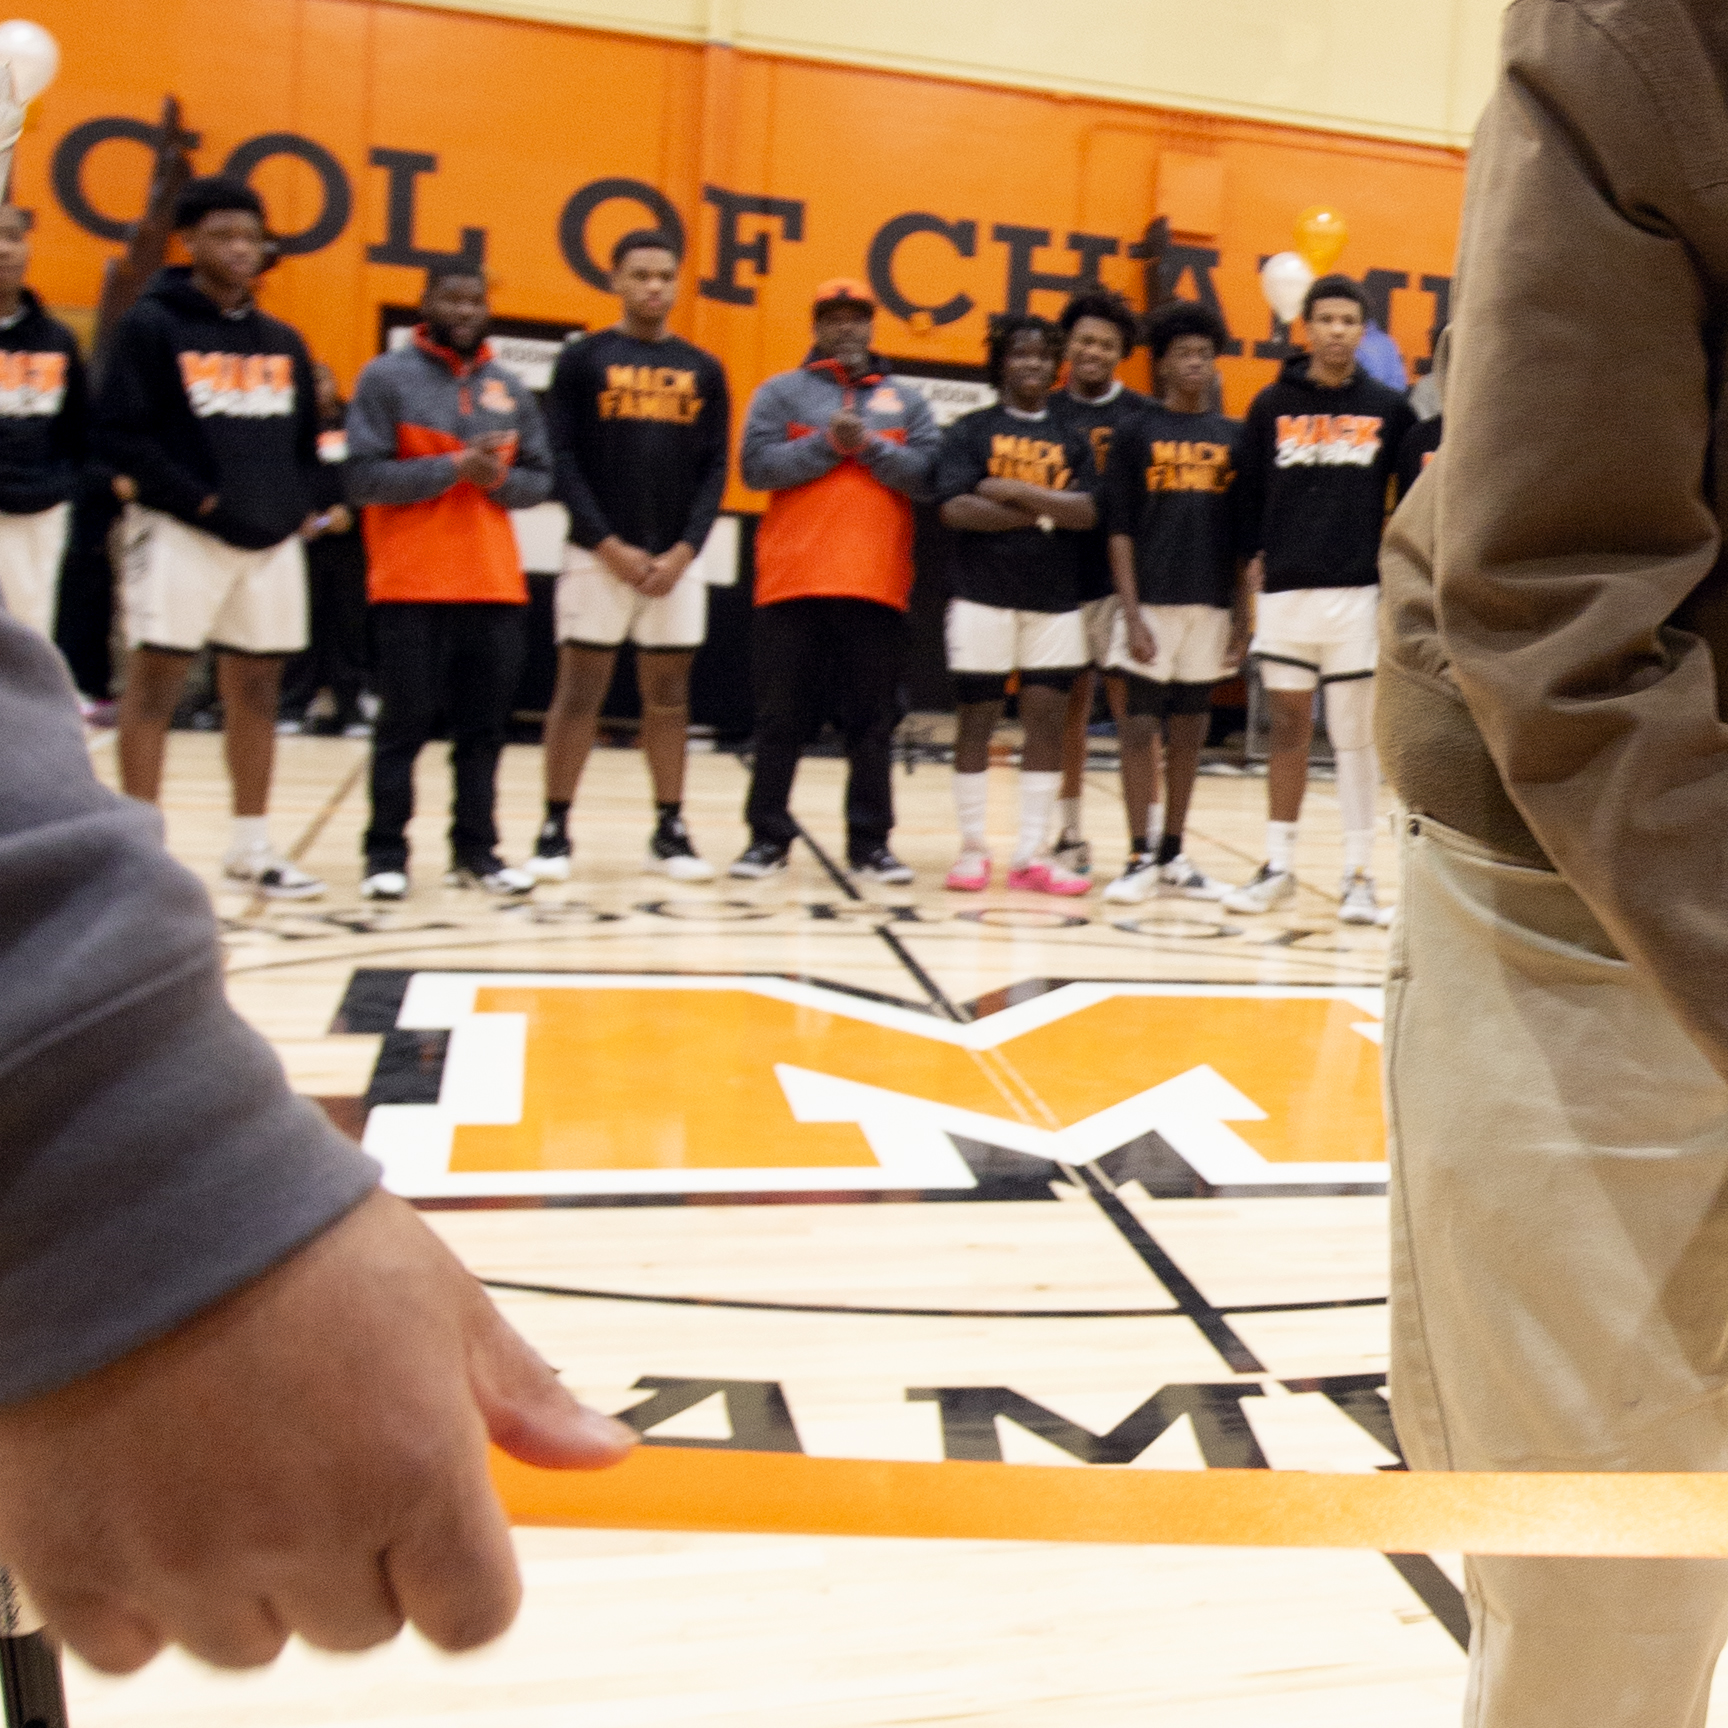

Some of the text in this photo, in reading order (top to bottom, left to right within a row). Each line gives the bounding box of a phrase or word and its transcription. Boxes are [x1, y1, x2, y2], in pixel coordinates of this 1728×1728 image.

[557, 176, 807, 307] OF
[605, 364, 696, 395] MACK
[598, 388, 704, 426] FAMILY
[1274, 413, 1384, 447] MACK
[990, 433, 1066, 466] MACK
[1150, 439, 1231, 467] MACK
